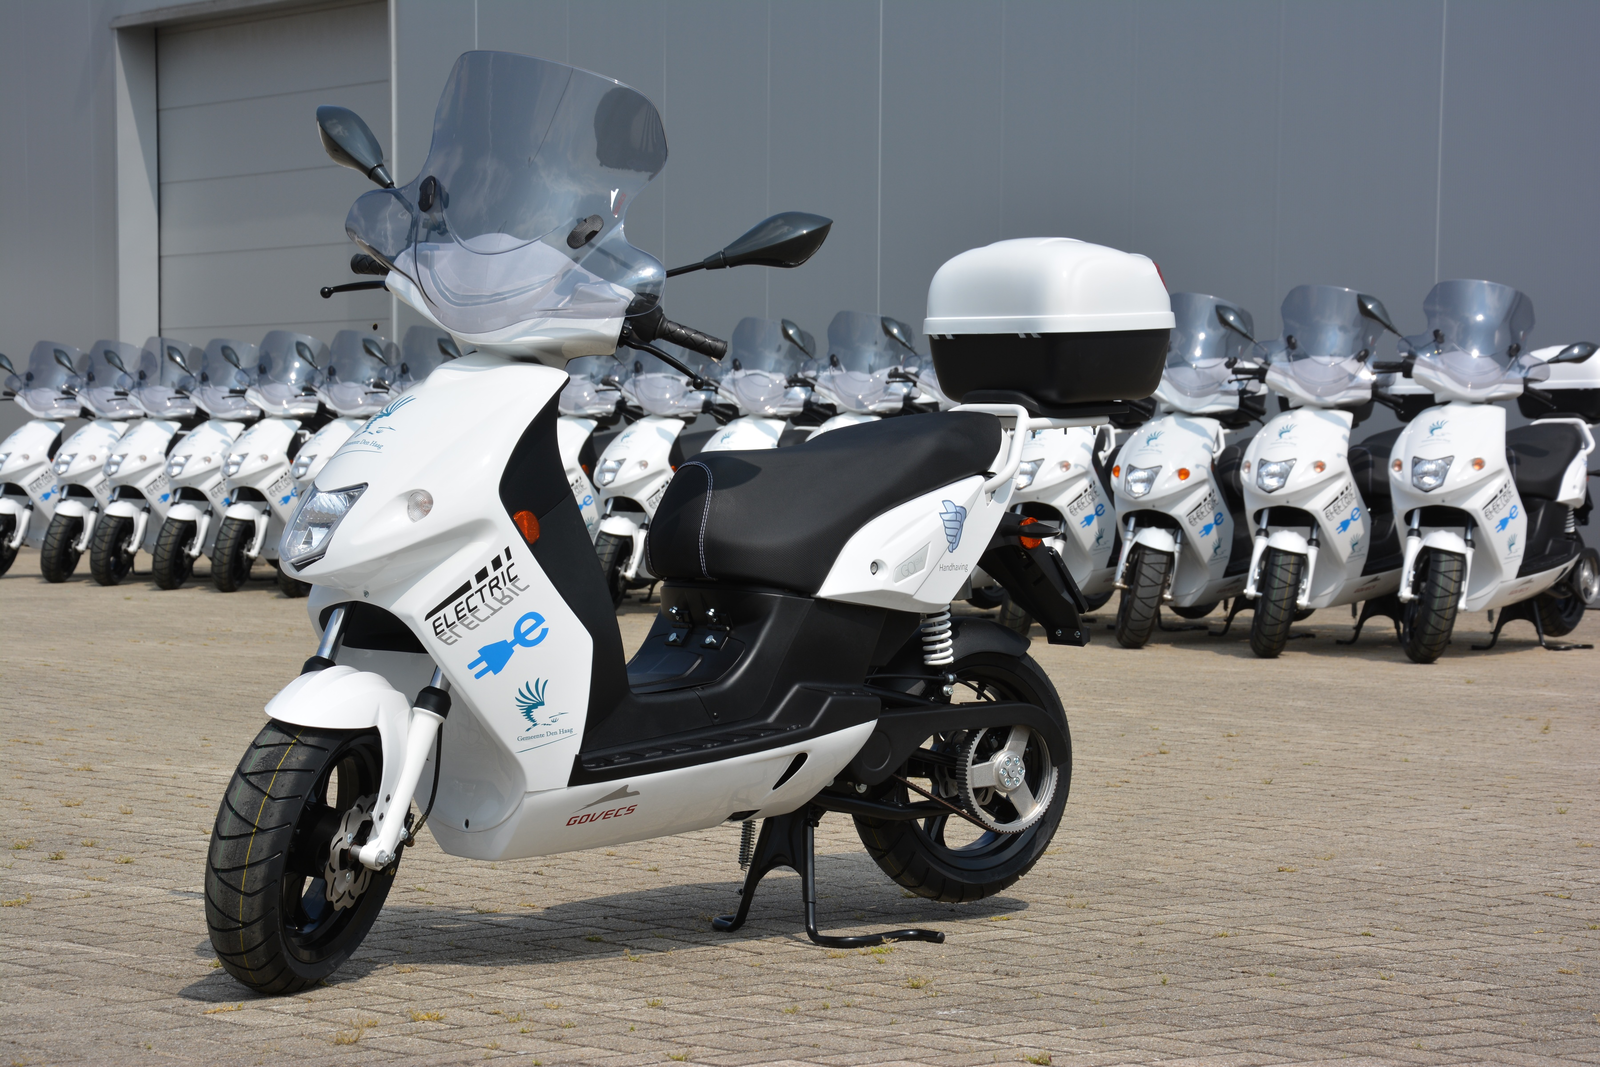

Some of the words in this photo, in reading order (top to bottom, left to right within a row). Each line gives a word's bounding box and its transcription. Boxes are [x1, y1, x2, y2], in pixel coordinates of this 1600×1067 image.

[939, 563, 968, 572] Handhaving
[432, 562, 518, 637] ELECTRIC
[565, 804, 638, 826] GOVECS
